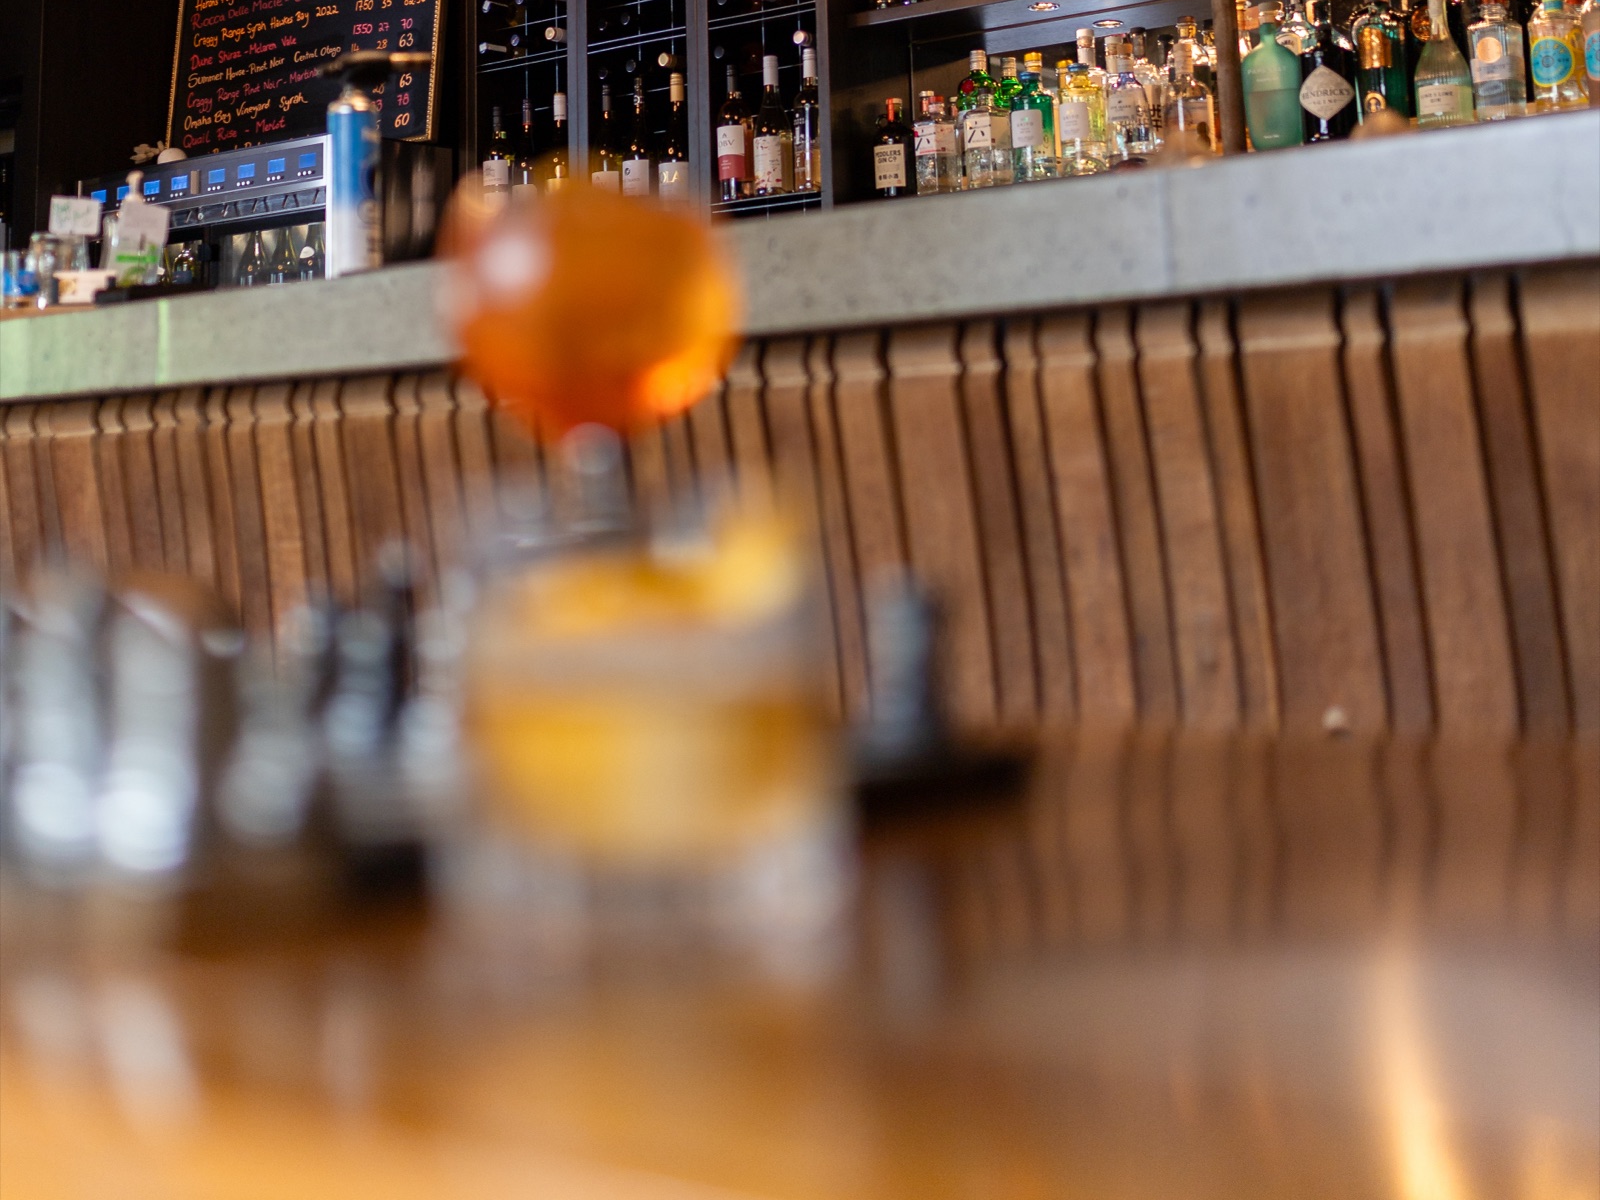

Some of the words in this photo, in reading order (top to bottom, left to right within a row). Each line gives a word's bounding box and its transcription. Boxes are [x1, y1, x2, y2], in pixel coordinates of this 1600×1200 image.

[191, 13, 225, 31] Rocca
[228, 6, 249, 19] Delle
[221, 27, 245, 42] Range
[246, 21, 267, 39] Syrah
[295, 11, 309, 28] Bay
[315, 5, 339, 18] 2022
[188, 72, 223, 88] Summer
[269, 57, 285, 69] Noir
[294, 49, 318, 63] Central
[320, 46, 341, 57] Otago
[376, 39, 388, 50] 28
[398, 32, 414, 48] 63
[190, 54, 213, 71] Dune
[218, 49, 242, 63] Shiraz
[281, 34, 297, 47] Vale
[378, 22, 390, 32] 27
[401, 18, 414, 30] 70
[216, 87, 239, 105] Range
[242, 83, 260, 96] Pinot
[263, 78, 283, 90] Noir
[399, 72, 413, 88] 65
[184, 115, 212, 131] Omaha
[214, 110, 231, 124] Bay
[236, 99, 270, 120] Vineyard
[279, 92, 308, 112] Syrah
[397, 92, 410, 106] 78
[182, 131, 211, 149] Quail
[216, 127, 238, 140] Rise
[255, 116, 286, 133] Merlot
[394, 112, 410, 128] 60
